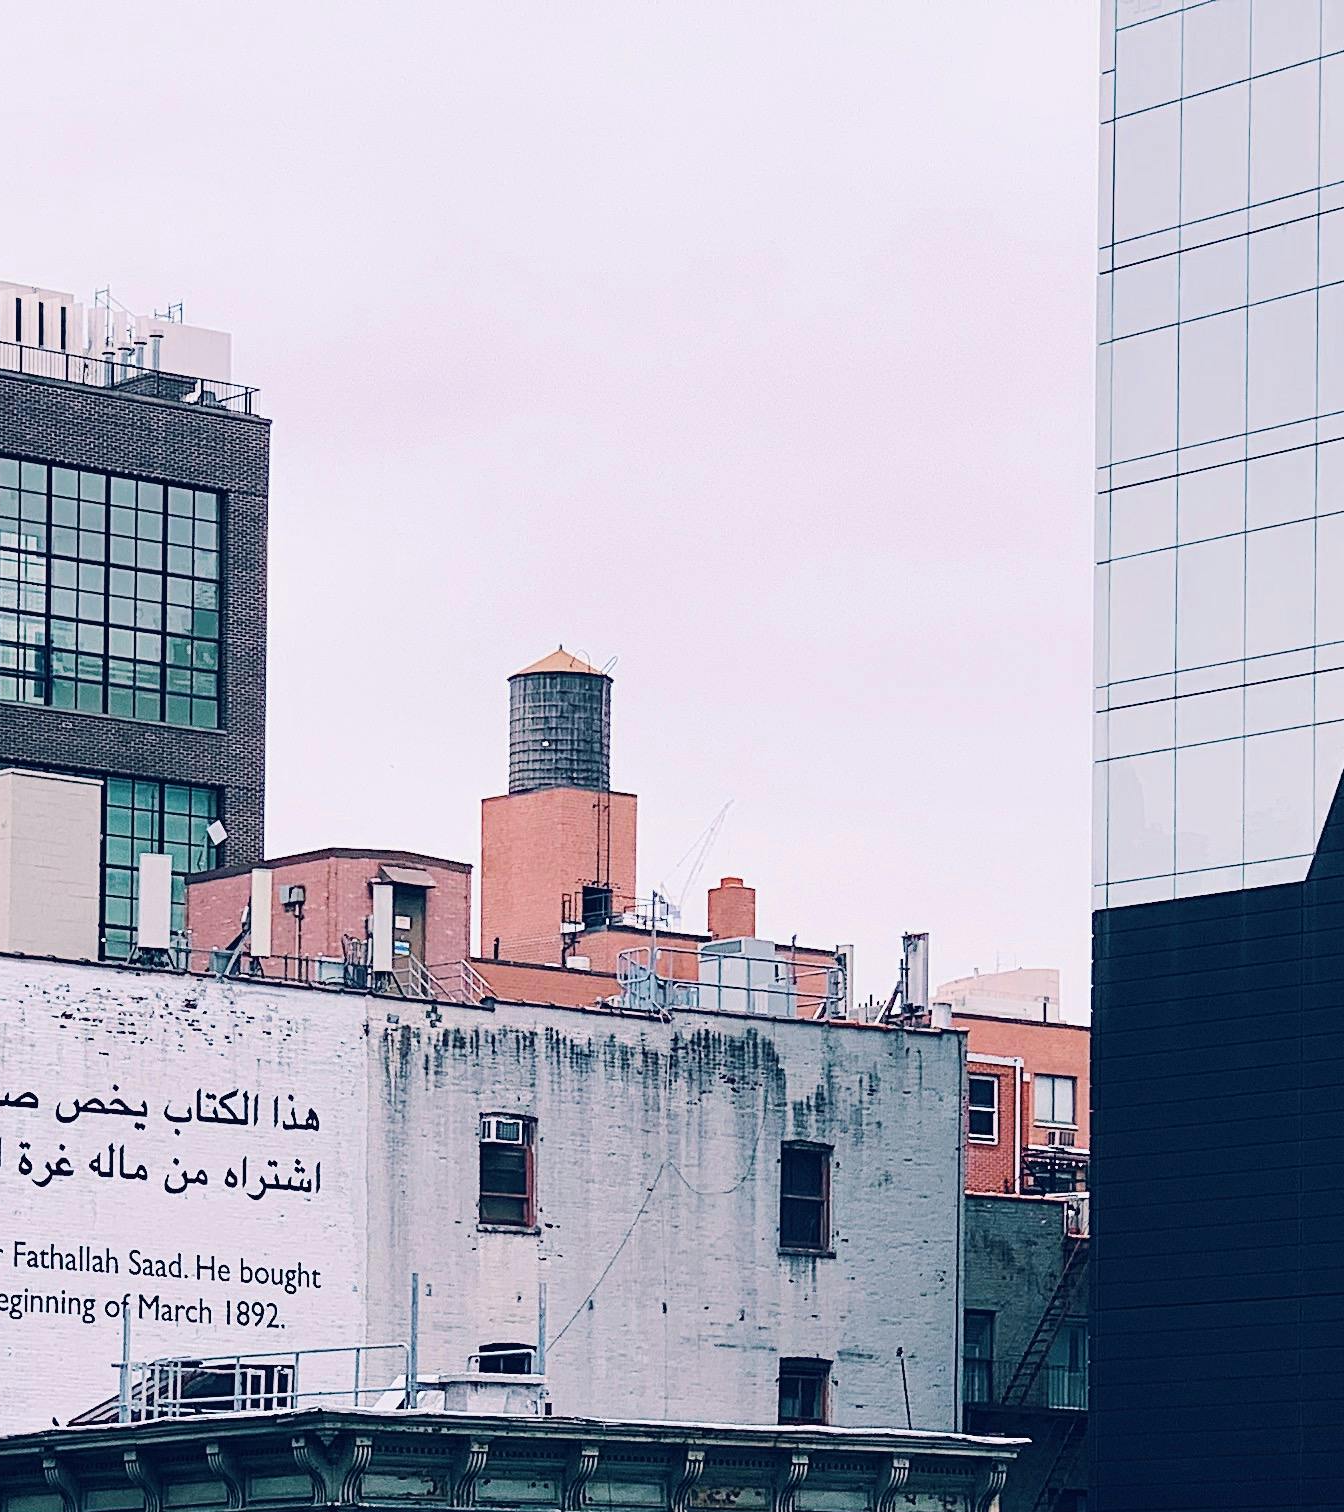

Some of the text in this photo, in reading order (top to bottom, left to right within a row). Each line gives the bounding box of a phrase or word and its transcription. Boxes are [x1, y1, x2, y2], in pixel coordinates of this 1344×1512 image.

[55, 1084, 148, 1131] يخص
[163, 1088, 259, 1136] الكتاب
[273, 1094, 320, 1132] هذا
[18, 1141, 75, 1188] غرة
[88, 1142, 148, 1181] ماله
[163, 1157, 208, 1194] من
[224, 1155, 321, 1202] اشتراه
[13, 1241, 119, 1274] Fathallah
[128, 1249, 188, 1280] Saad.
[197, 1255, 231, 1282] He
[240, 1258, 322, 1295] bought
[105, 1293, 131, 1318] of
[138, 1293, 212, 1325] March
[225, 1299, 285, 1329] 1892.
